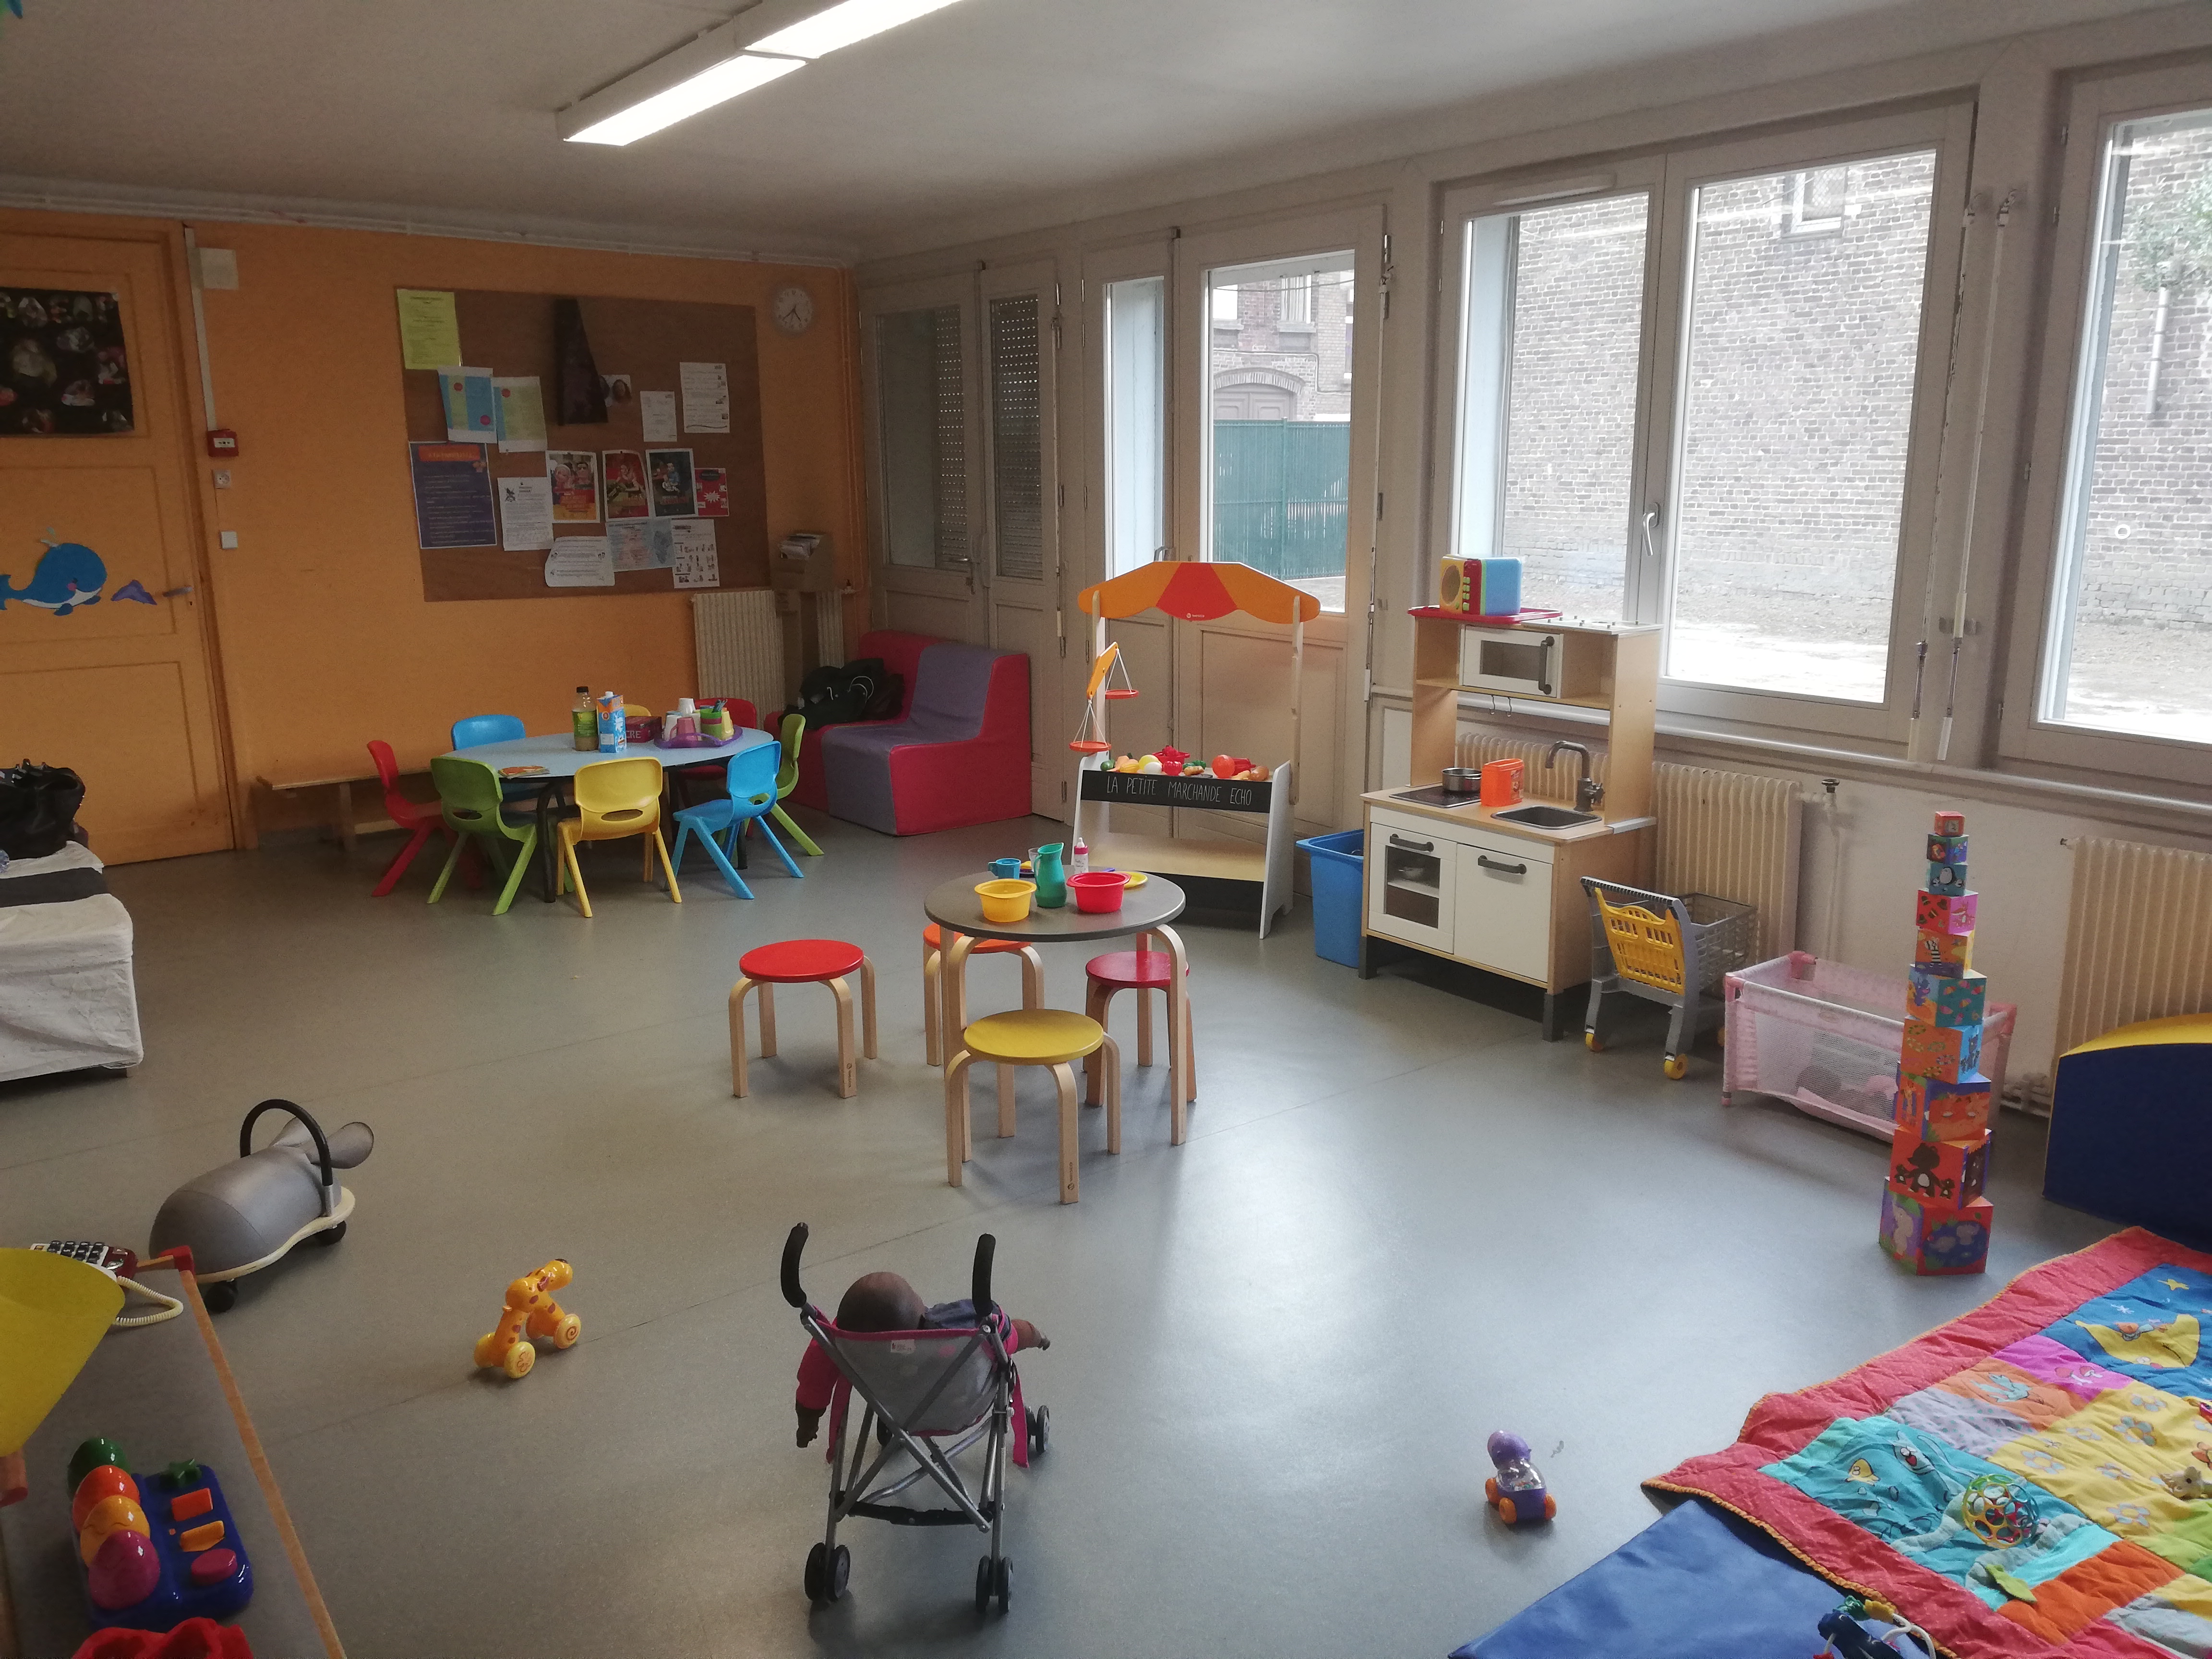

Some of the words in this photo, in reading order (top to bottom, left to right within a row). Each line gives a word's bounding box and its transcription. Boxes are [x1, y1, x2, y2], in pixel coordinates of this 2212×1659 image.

[1107, 775, 1118, 794] LA
[1167, 781, 1222, 803] MARCHANDE
[1230, 788, 1252, 806] ECHO
